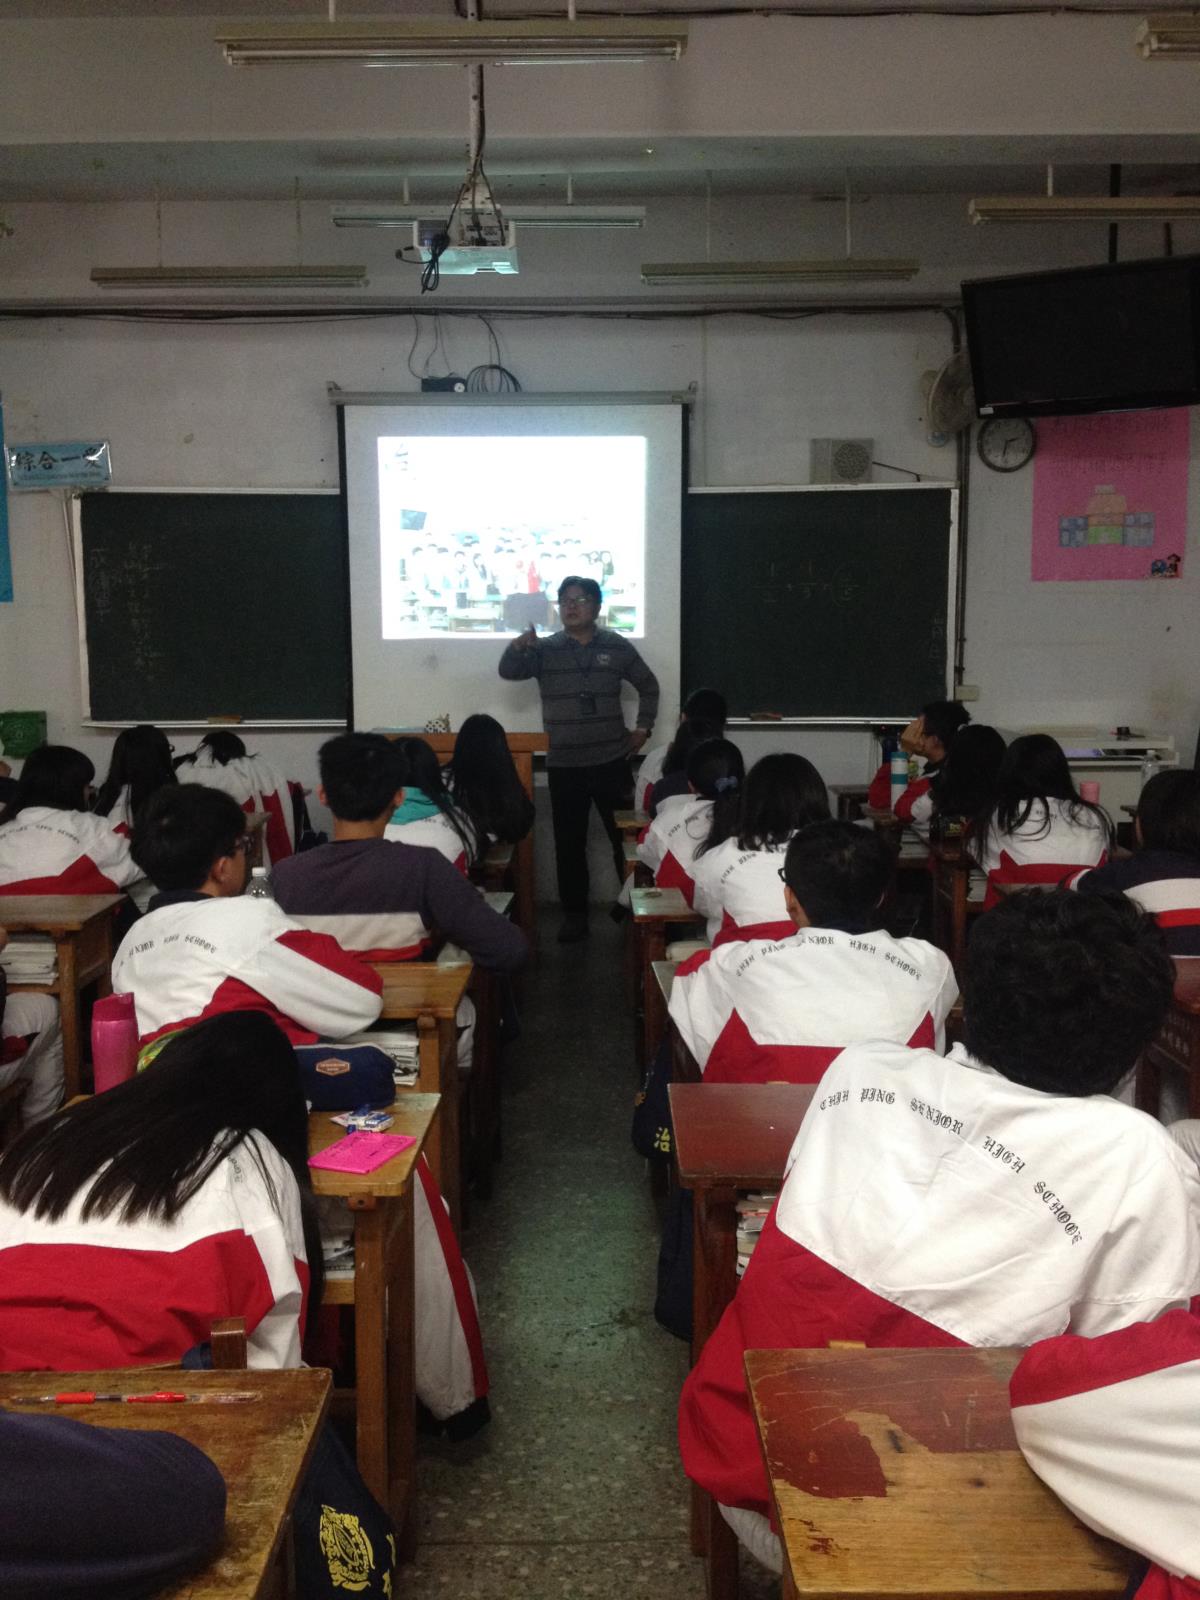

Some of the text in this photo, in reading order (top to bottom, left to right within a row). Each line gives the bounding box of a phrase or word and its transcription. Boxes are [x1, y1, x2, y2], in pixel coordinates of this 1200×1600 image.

[849, 939, 876, 955] HIGH
[884, 950, 922, 981] SCHOOL
[819, 1087, 1083, 1245] CHIH PING SENIOR HIGH SCHOOL
